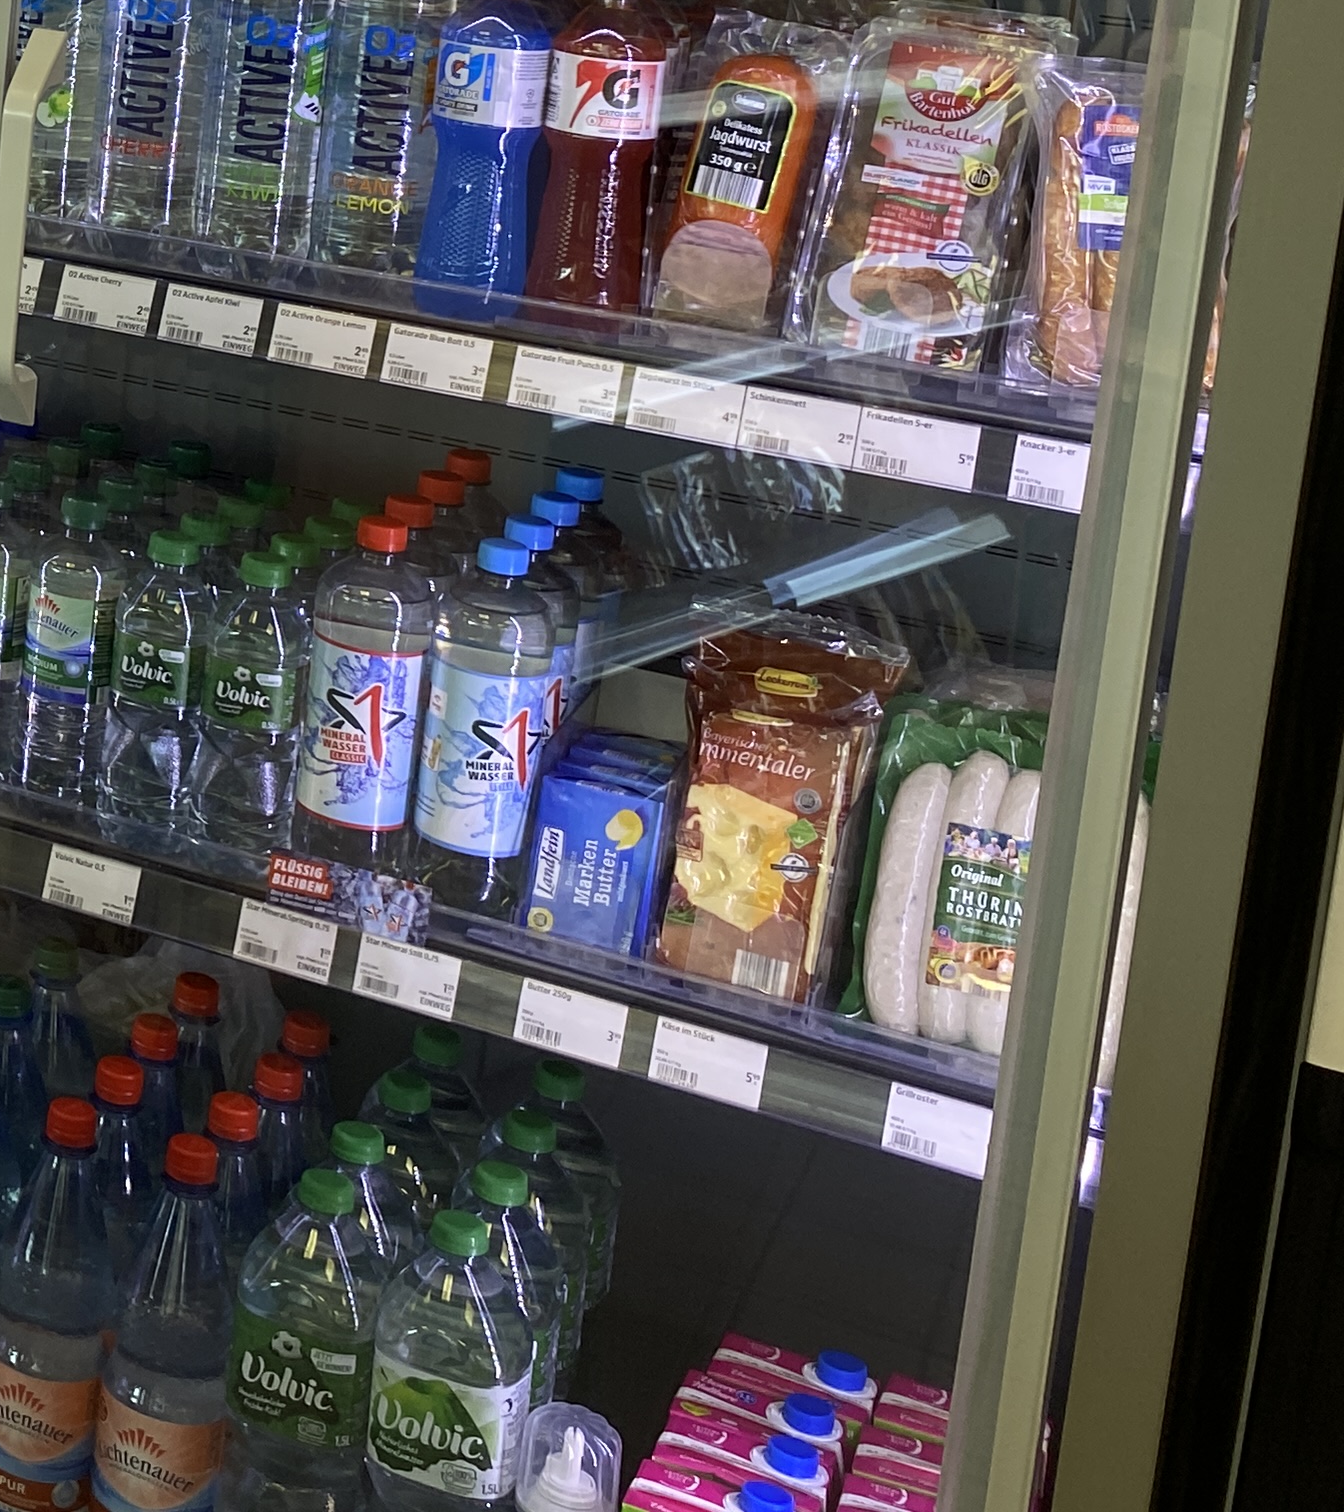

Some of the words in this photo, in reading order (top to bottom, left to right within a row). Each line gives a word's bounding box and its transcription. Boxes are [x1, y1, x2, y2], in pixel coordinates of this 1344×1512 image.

[113, 17, 174, 139] ACTIVE
[233, 44, 294, 164] ACTIVE
[929, 92, 956, 108] Gut
[724, 117, 763, 136] Delikatess
[880, 116, 994, 147] Frikadellen
[711, 125, 772, 155] Jagdwurst
[905, 138, 961, 155] KLASSIK
[709, 153, 731, 167] 350
[80, 272, 99, 281] Active
[100, 275, 123, 288] Cherry
[184, 291, 204, 302] Active
[205, 294, 223, 306] Apfel
[117, 321, 146, 333] EINWEG
[292, 310, 313, 321] Active
[315, 315, 339, 328] Orange
[341, 319, 366, 331] Lemon
[394, 326, 426, 339] Gatorade
[428, 332, 442, 342] Blue
[223, 340, 253, 353] EINWEG
[449, 381, 482, 394] EINWEG
[750, 391, 807, 409] Schinkenmett
[866, 411, 912, 428] Frikadellen
[1020, 439, 1055, 454] Knacker
[1057, 445, 1077, 457] 3-er
[122, 653, 172, 686] Volvic
[217, 679, 270, 709] Volvic
[321, 726, 366, 743] MINERAL
[322, 737, 366, 753] WASSER
[330, 749, 366, 763] CLASSIC
[698, 742, 816, 781] mmentaler
[466, 760, 514, 774] MINERAL
[468, 770, 513, 782] WASSER
[55, 850, 73, 863] Volvic
[75, 856, 94, 867] Natur
[536, 827, 561, 897] Landfein
[273, 857, 322, 879] FLÜSSIG
[573, 839, 597, 908] Marken
[951, 864, 1004, 888] Original
[272, 871, 330, 896] BLEIBEN!
[594, 849, 617, 907] Butter
[246, 900, 262, 912] Star
[948, 884, 1023, 917] THÜRIN
[102, 907, 131, 923] EINWEG
[366, 935, 382, 946] Star
[297, 962, 327, 978] EINWEG
[527, 981, 551, 997] Butter
[240, 1351, 334, 1412] Volvic
[376, 1397, 484, 1462] Volvic
